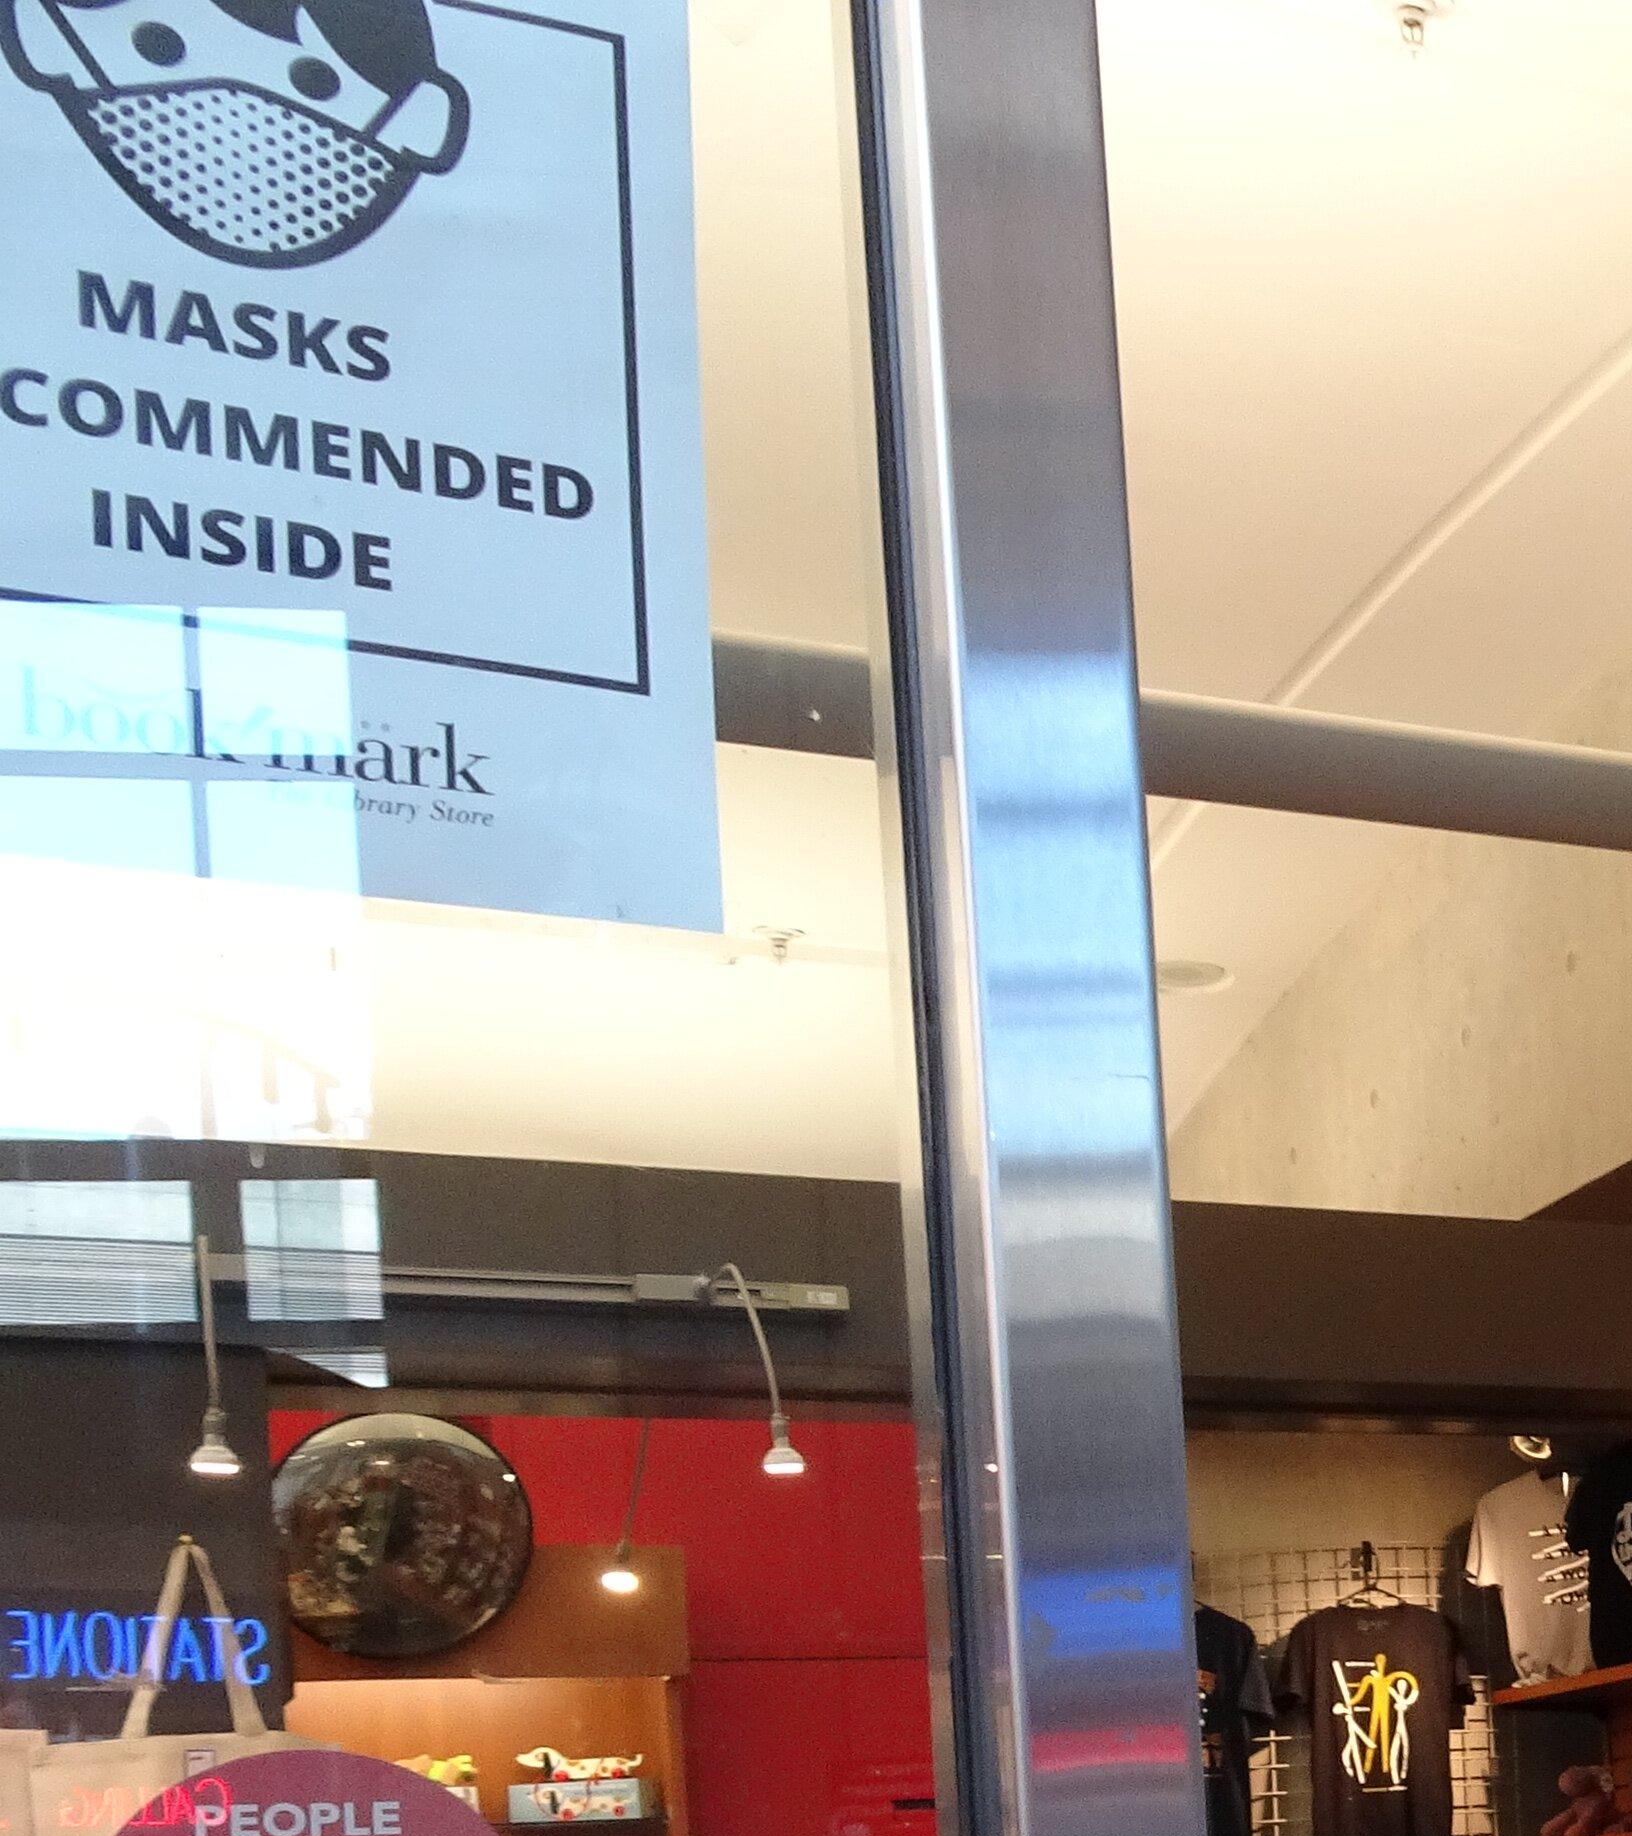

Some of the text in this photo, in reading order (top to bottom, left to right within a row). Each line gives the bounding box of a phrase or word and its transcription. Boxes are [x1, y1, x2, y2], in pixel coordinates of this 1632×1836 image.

[77, 269, 391, 381] MASKS
[91, 489, 393, 591] INSIDE
[430, 799, 494, 827] Store
